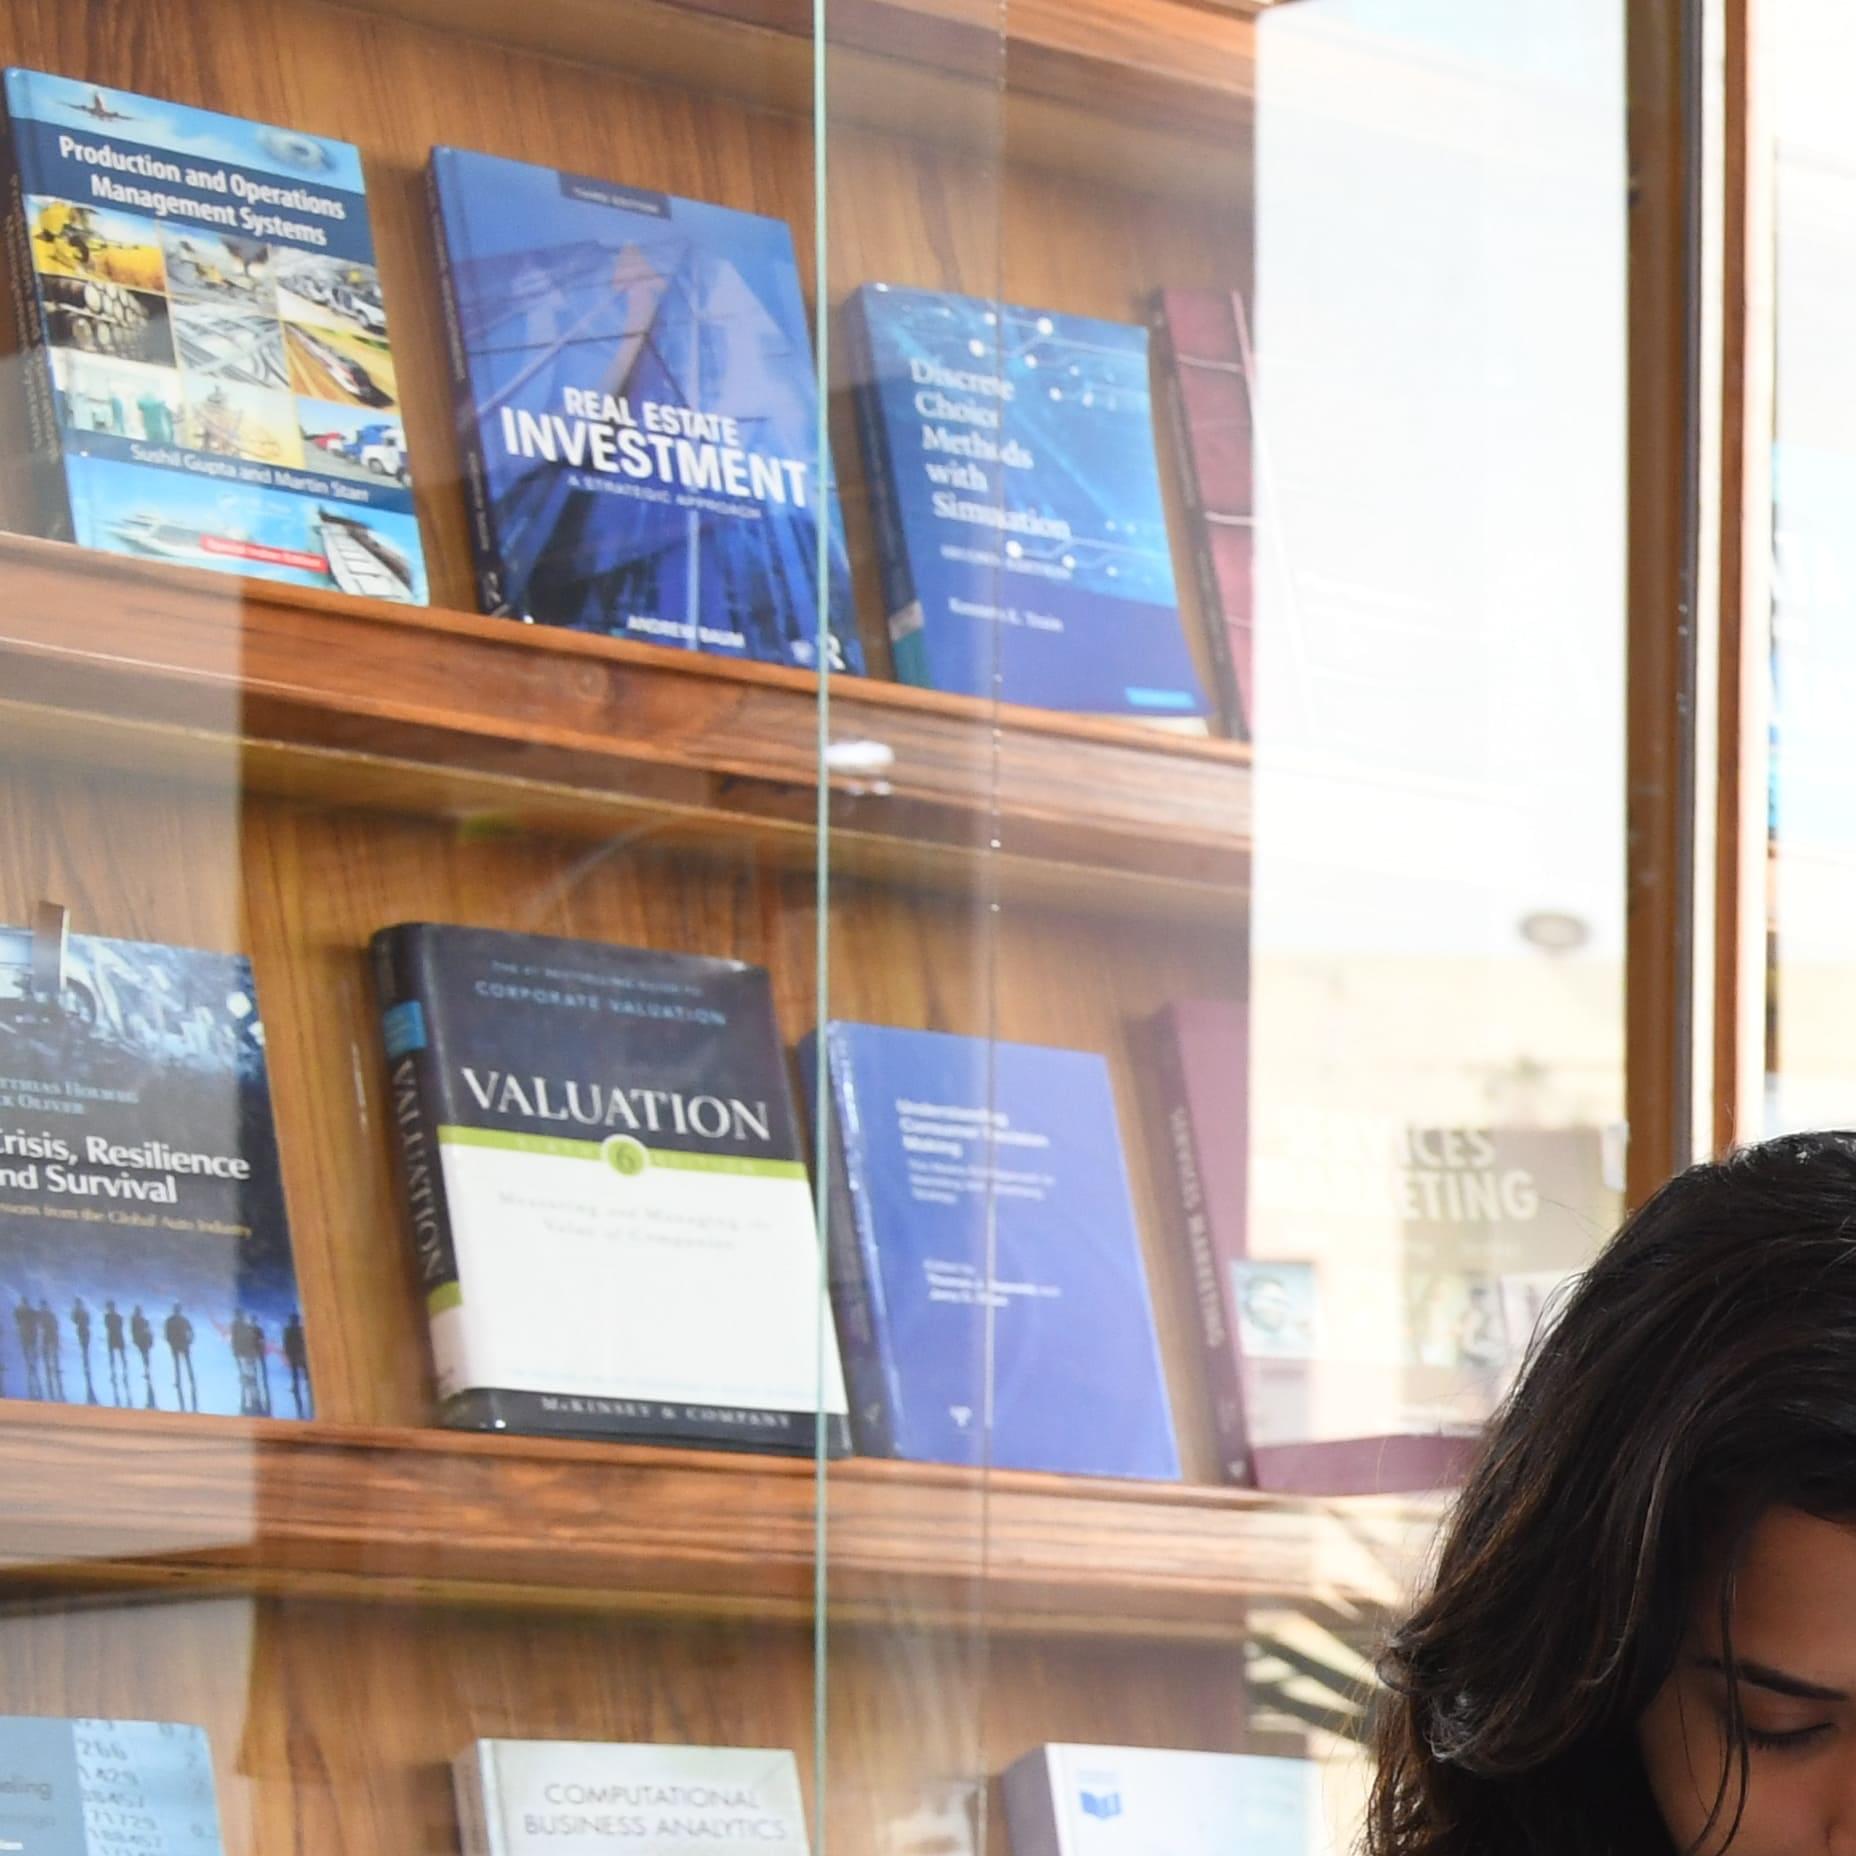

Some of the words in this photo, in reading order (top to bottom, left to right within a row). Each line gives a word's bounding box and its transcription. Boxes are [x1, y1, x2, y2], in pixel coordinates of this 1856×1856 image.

[59, 135, 181, 184] Production
[185, 163, 227, 193] and
[230, 174, 346, 219] Operations
[91, 174, 238, 228] Management
[239, 206, 327, 246] Systems
[910, 358, 1015, 401] Discrete
[563, 386, 638, 427] REAL
[642, 401, 740, 447] ESTATE
[914, 391, 999, 429] Choice
[501, 406, 808, 508] INVESTMENT
[922, 424, 1034, 470] Methods
[925, 461, 989, 492] with
[932, 491, 1072, 538] Simulation
[475, 980, 599, 1010] CORPORATE
[608, 1000, 727, 1026] VALUATION
[461, 1067, 771, 1141] VALUATION
[86, 1135, 250, 1180] Resilience
[393, 1058, 445, 1280] VALUATION
[45, 1165, 178, 1204] Survival
[543, 1783, 761, 1809] COMPUTATIONAL
[523, 1815, 648, 1838] BUSINESS
[656, 1818, 788, 1842] ANALYTICS
